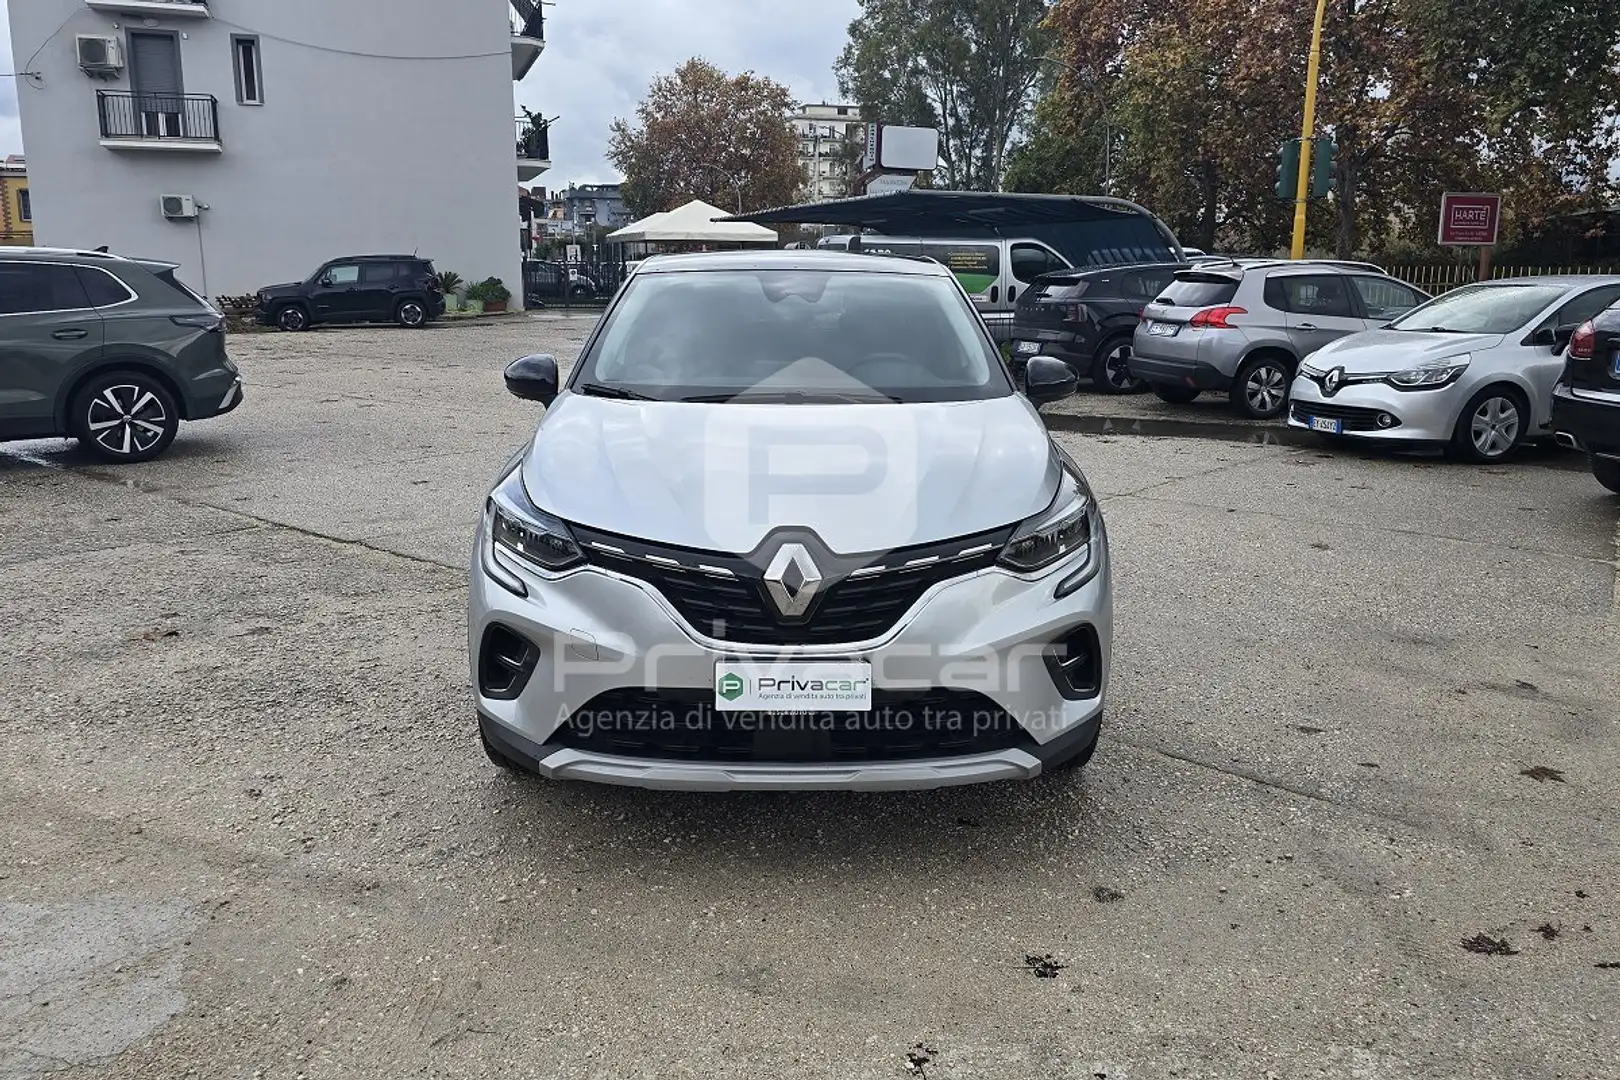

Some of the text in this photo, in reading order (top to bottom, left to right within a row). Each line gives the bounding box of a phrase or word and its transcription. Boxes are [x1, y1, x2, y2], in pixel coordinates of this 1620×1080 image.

[758, 675, 869, 691] Privacar
[758, 692, 785, 701] Agenzia
[785, 692, 793, 700] di
[794, 692, 818, 700] vendita
[845, 692, 867, 701] privati
